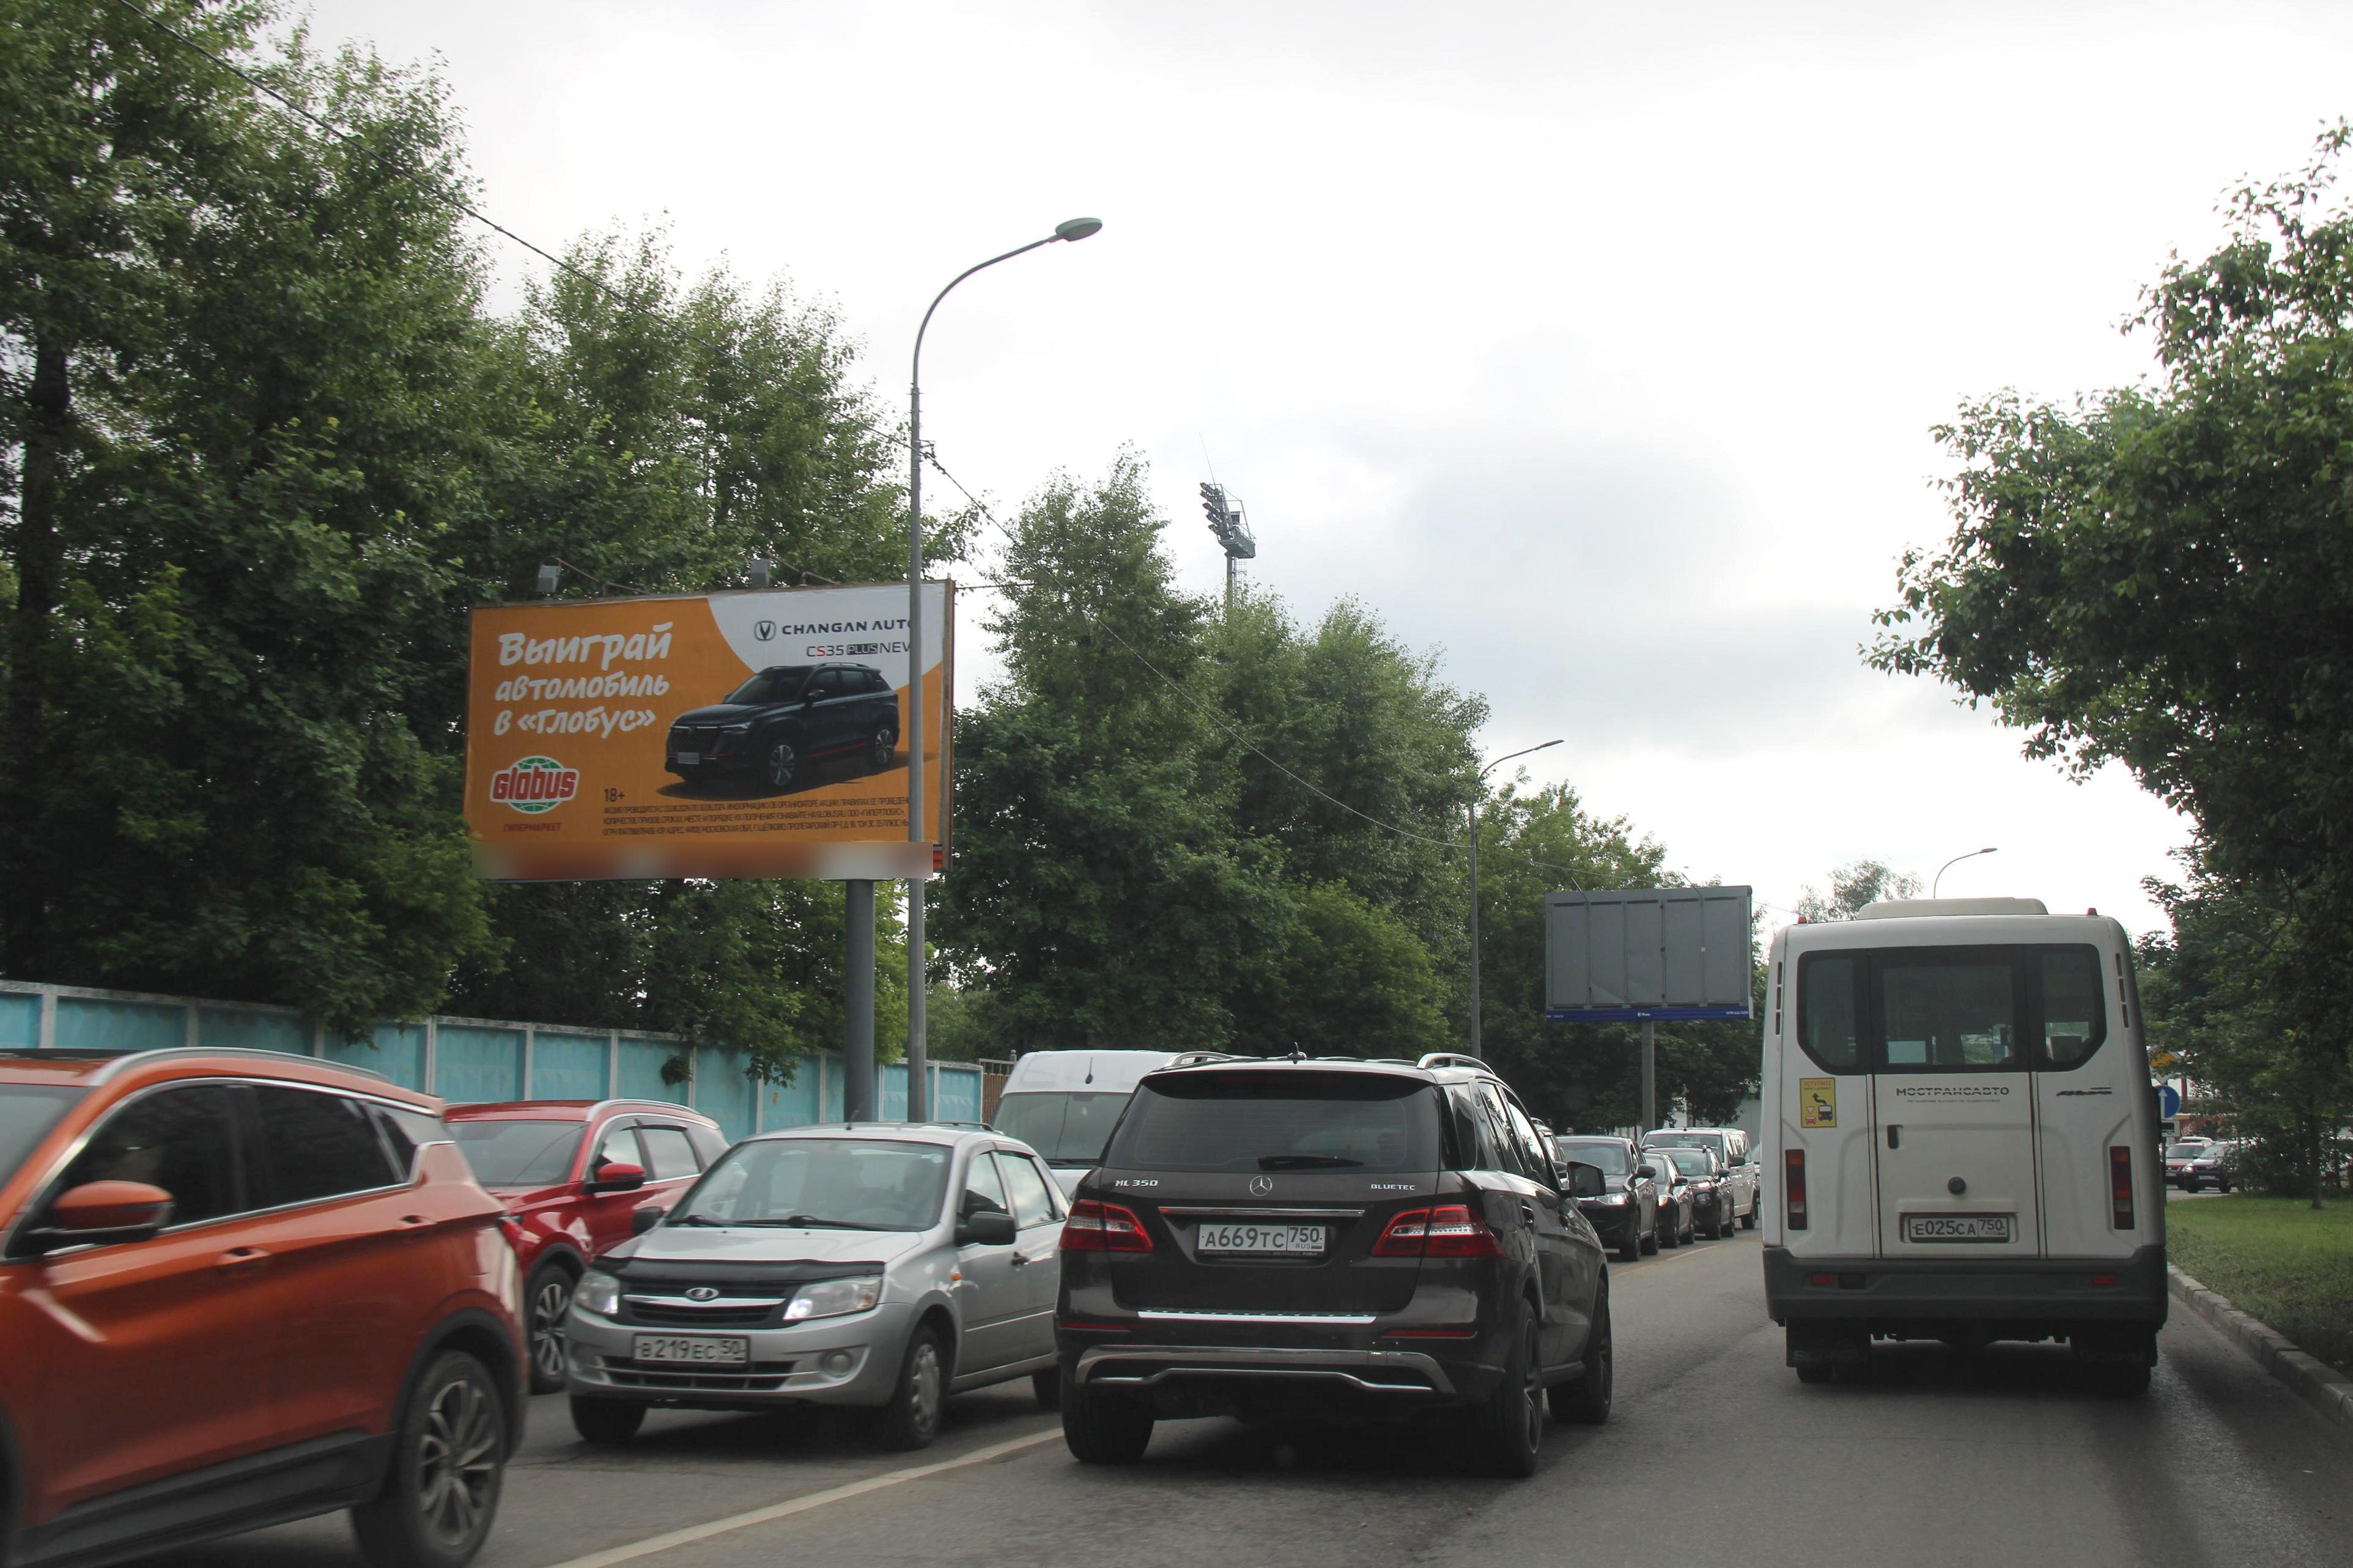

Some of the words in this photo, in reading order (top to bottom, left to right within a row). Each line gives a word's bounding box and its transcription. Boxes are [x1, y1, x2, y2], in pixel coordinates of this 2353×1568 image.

[782, 620, 867, 635] CHANGAN
[872, 619, 910, 631] AUT
[498, 622, 673, 671] Выиграй
[807, 645, 844, 657] CS35
[847, 644, 877, 655] PLUS
[495, 671, 670, 702] автомобиль
[494, 710, 512, 736] в
[493, 765, 577, 800] Globus
[604, 788, 625, 802] 18+
[1896, 1087, 2009, 1096] МОСТРАНСАВТО
[1979, 1219, 2003, 1231] 750
[1205, 1227, 1284, 1248] А669ТС
[1289, 1227, 1320, 1243] 750
[722, 1339, 740, 1355] 50
